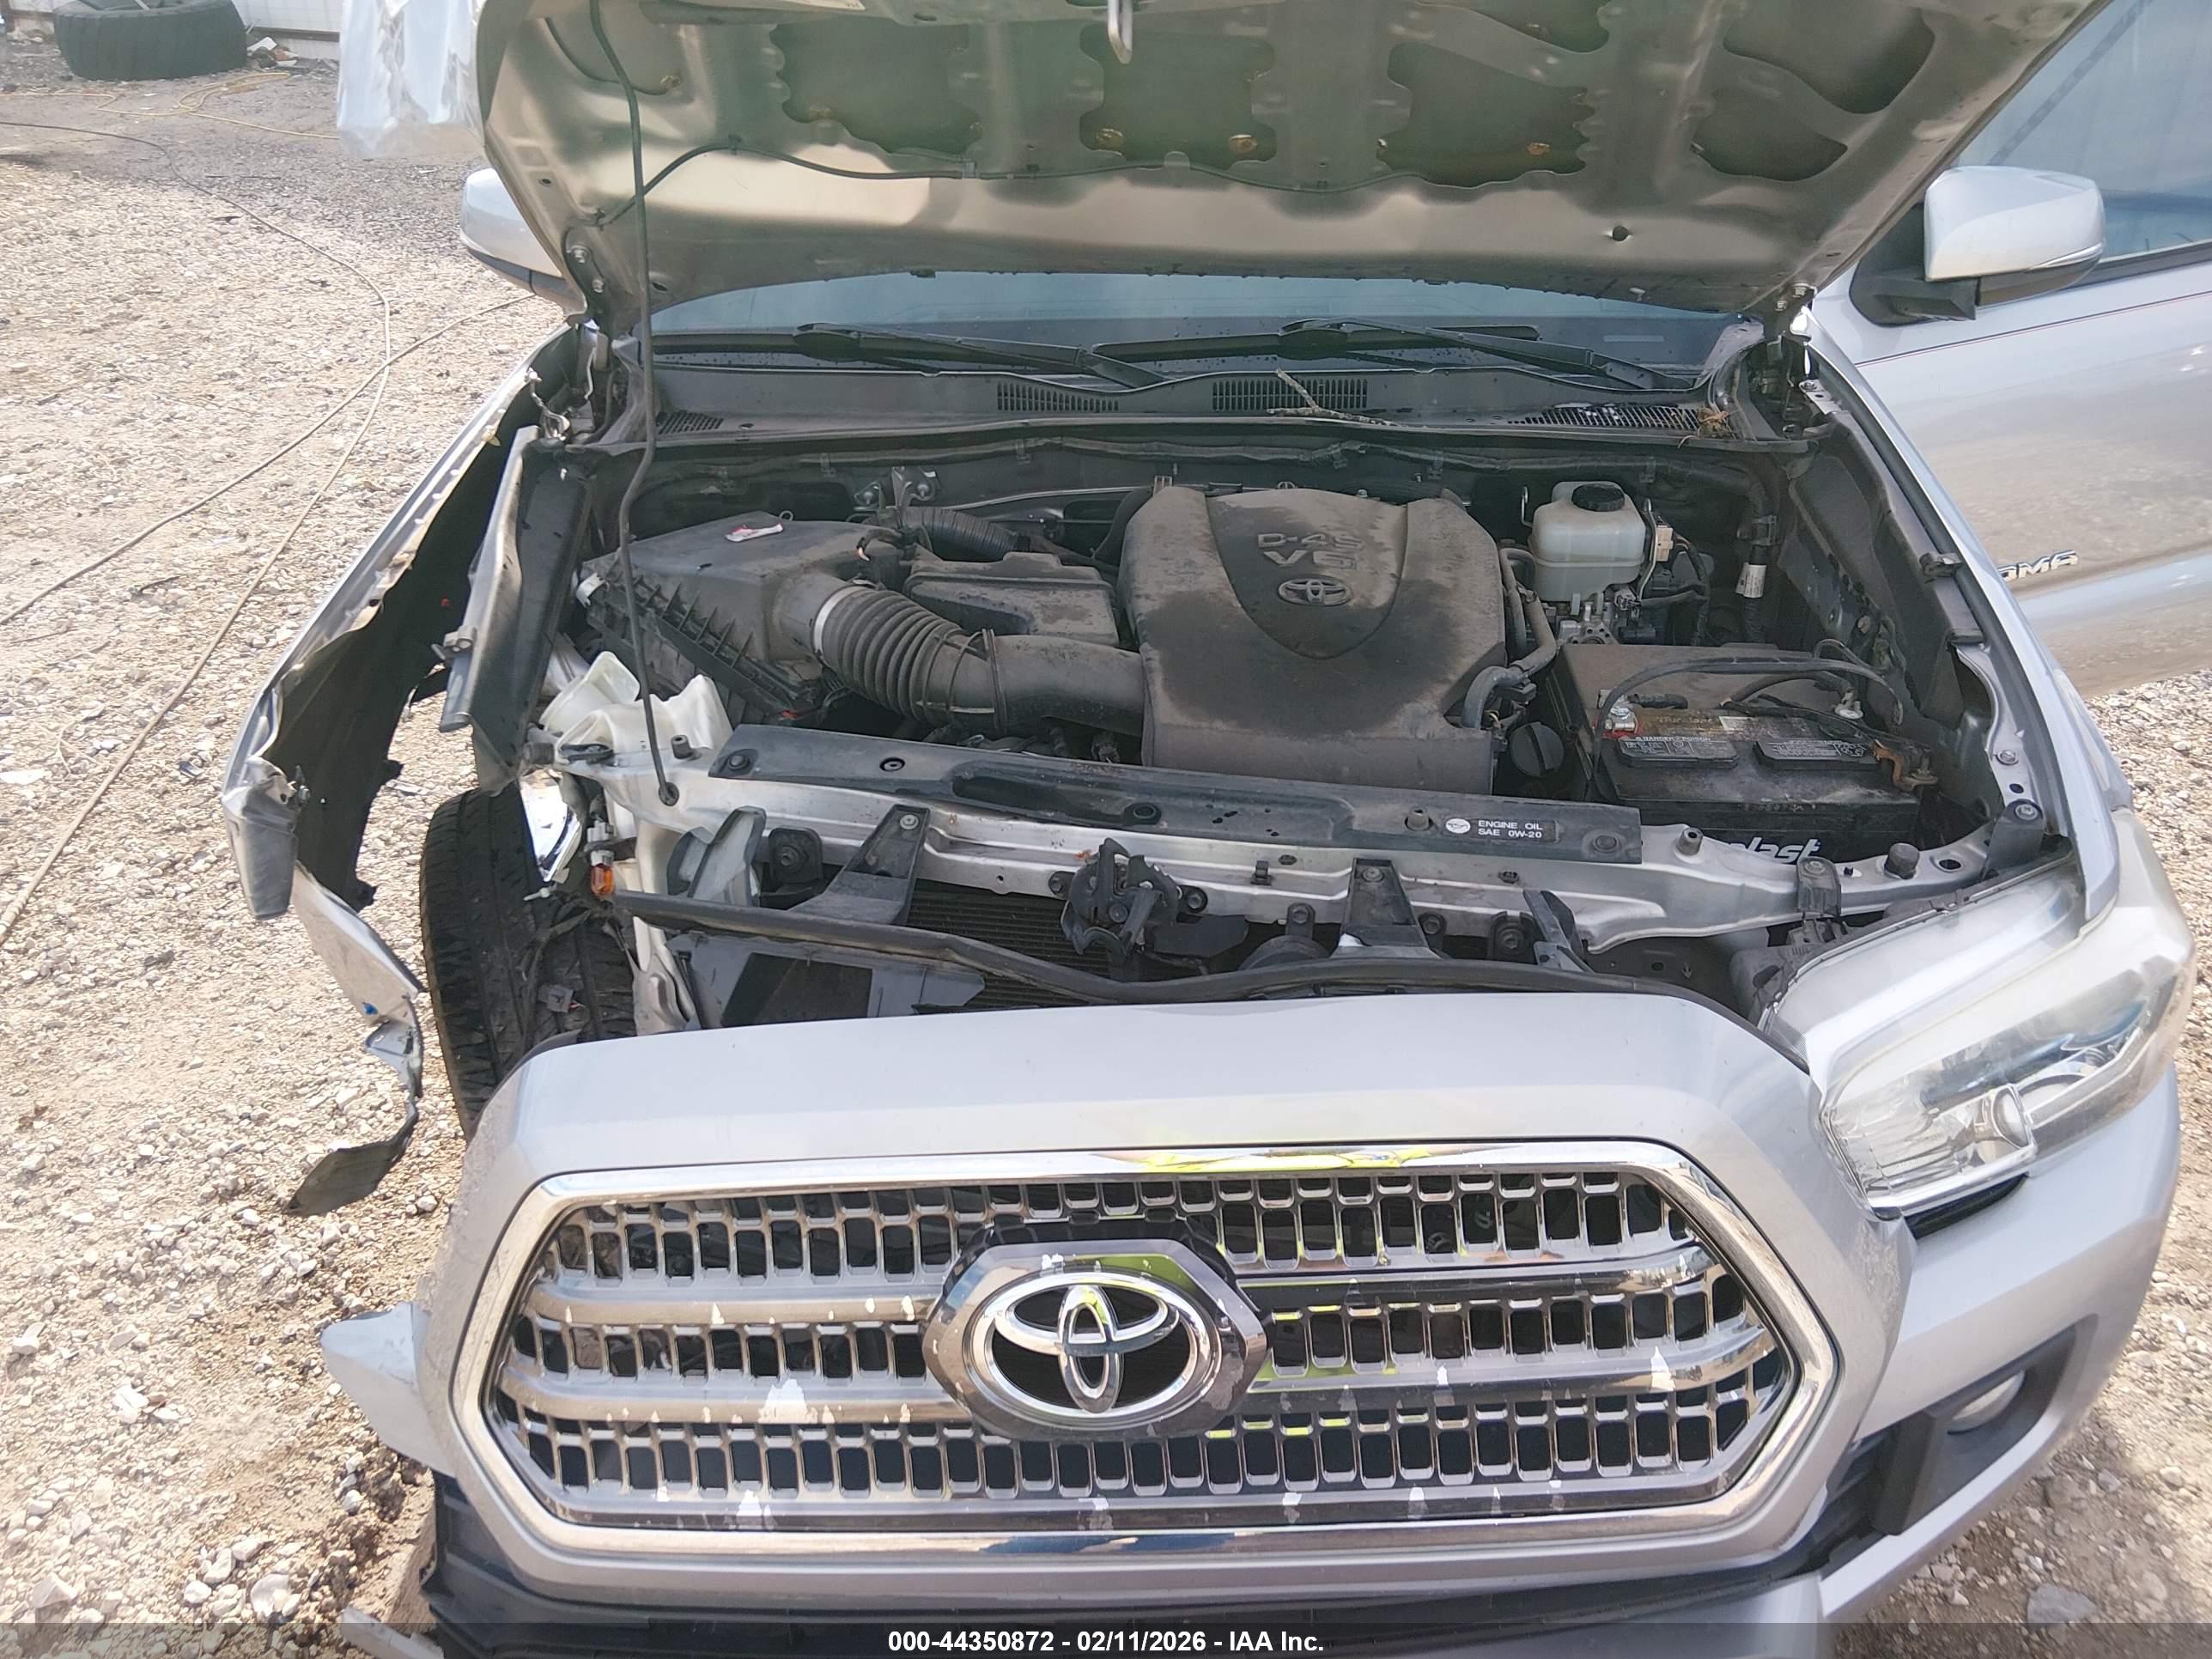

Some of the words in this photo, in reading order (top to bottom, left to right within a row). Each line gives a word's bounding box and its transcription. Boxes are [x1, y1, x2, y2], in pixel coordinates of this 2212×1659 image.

[1263, 549, 1358, 569] V6
[1478, 819, 1518, 830] ENGINE
[1524, 822, 1543, 830] OIL
[1478, 828, 1500, 836] SAE
[1508, 830, 1543, 839] 0W-20
